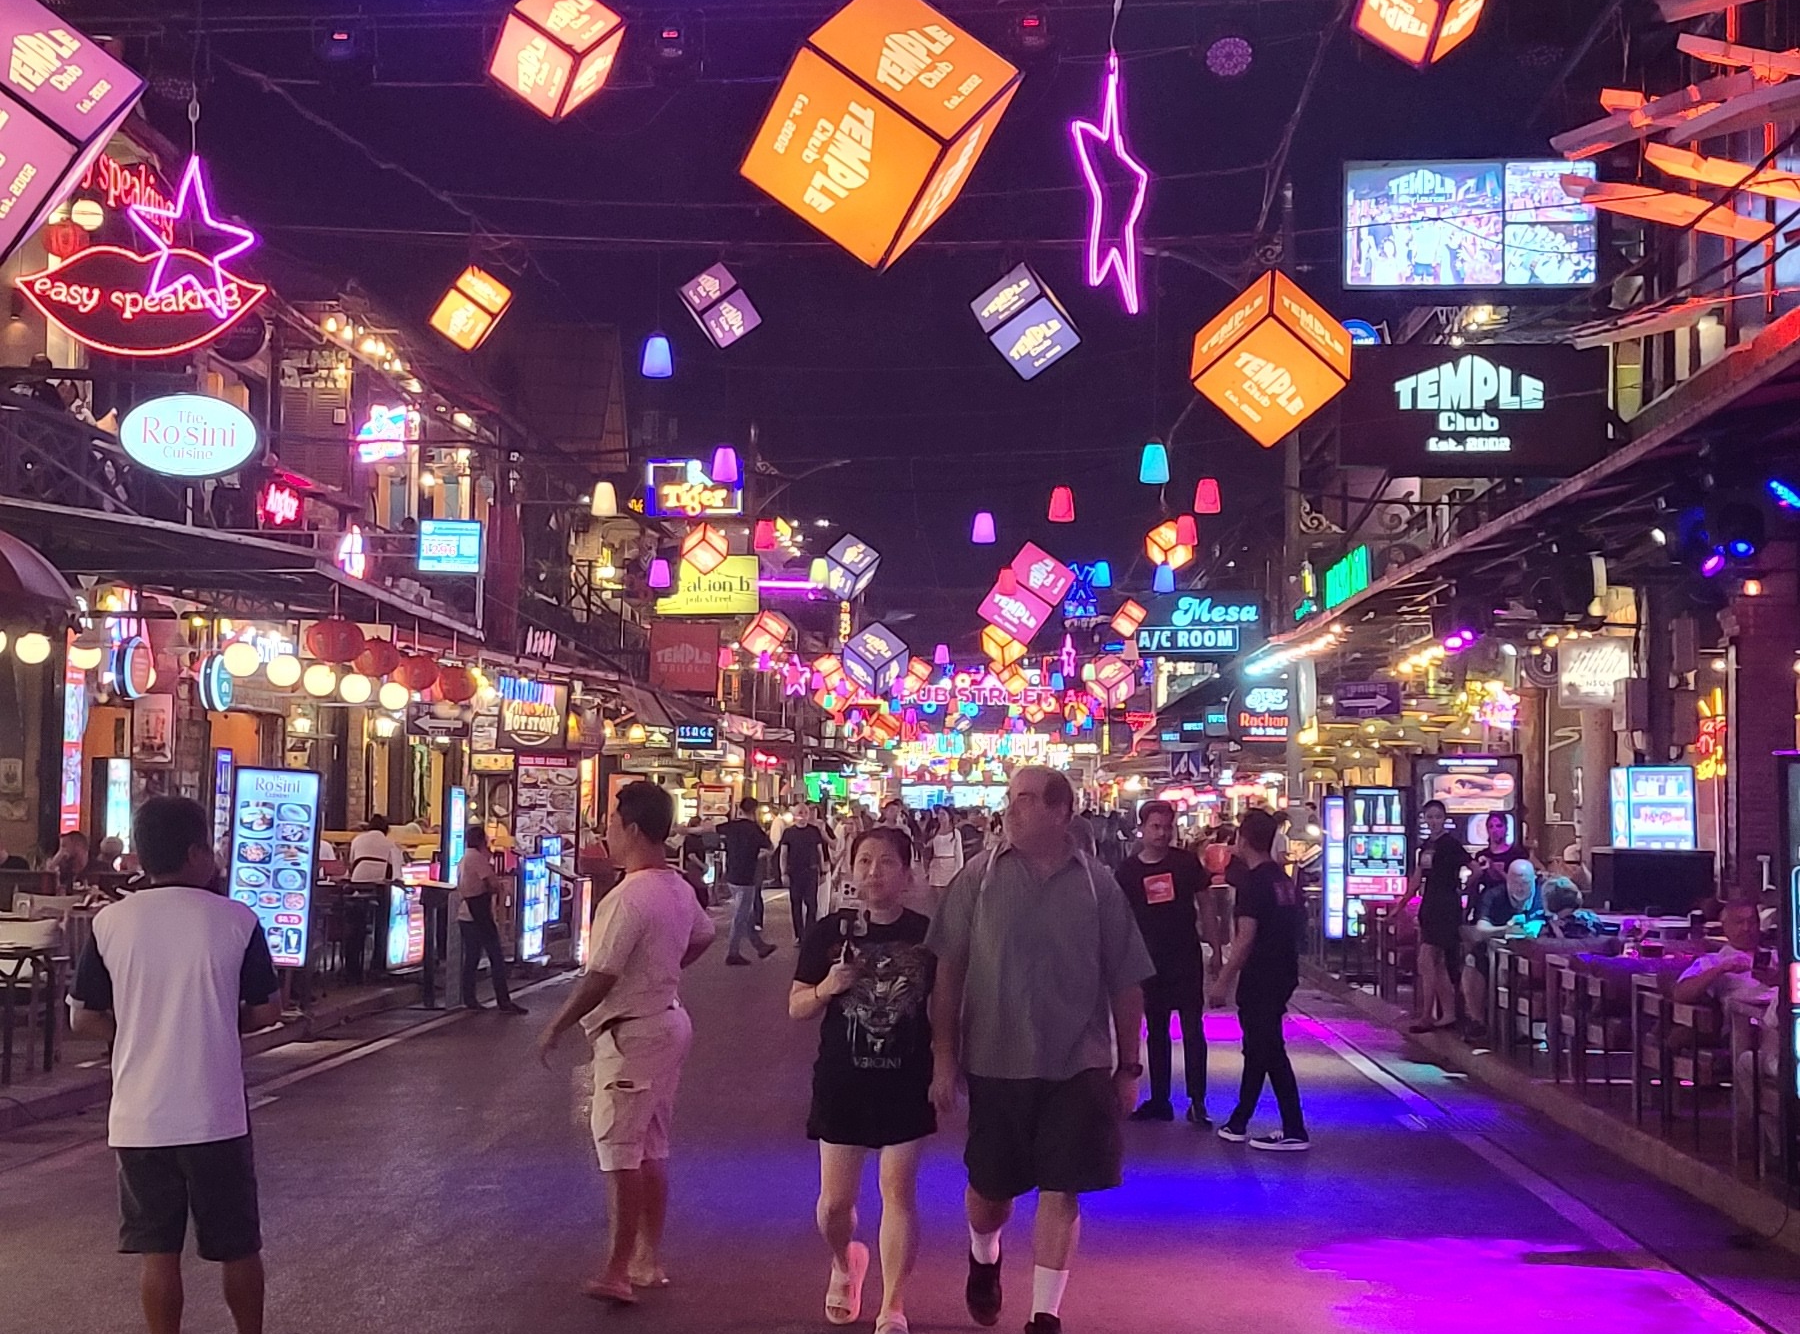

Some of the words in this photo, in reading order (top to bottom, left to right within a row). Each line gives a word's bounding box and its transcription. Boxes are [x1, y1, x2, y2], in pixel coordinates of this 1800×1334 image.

[9, 28, 81, 93] TEMPLE
[876, 24, 956, 92] TEMPLE
[50, 64, 83, 91] Club
[918, 61, 954, 89] Club
[801, 118, 835, 164] Club
[802, 100, 876, 213] TEMPLE
[9, 163, 37, 196] 2002
[1388, 169, 1457, 195] TEMPLE
[98, 153, 175, 246] speaking
[34, 277, 100, 313] easy
[110, 283, 242, 319] speaking
[981, 278, 1030, 318] TEMPLE
[1009, 319, 1062, 361] TEMPLE
[1201, 295, 1264, 355] TEMPLE
[1281, 295, 1345, 357] TEMPLE
[1234, 351, 1305, 416] TEMPLE
[1394, 354, 1545, 410] TEMPLE
[141, 417, 236, 448] Rosini
[177, 410, 204, 424] The
[1438, 411, 1500, 432] Club
[163, 446, 213, 460] Cuisine
[1427, 436, 1464, 452] Est.
[1465, 436, 1511, 452] 2002
[662, 483, 728, 517] Tiger
[739, 575, 751, 592] b
[993, 593, 1037, 629] TEMPLE
[1171, 597, 1259, 626] Mesa
[656, 643, 713, 664] TEMPLE
[1138, 629, 1172, 651] A/C
[1176, 629, 1233, 648] ROOM
[900, 686, 950, 704] PUB
[955, 686, 1054, 706] STREET
[255, 777, 300, 793] Rosini
